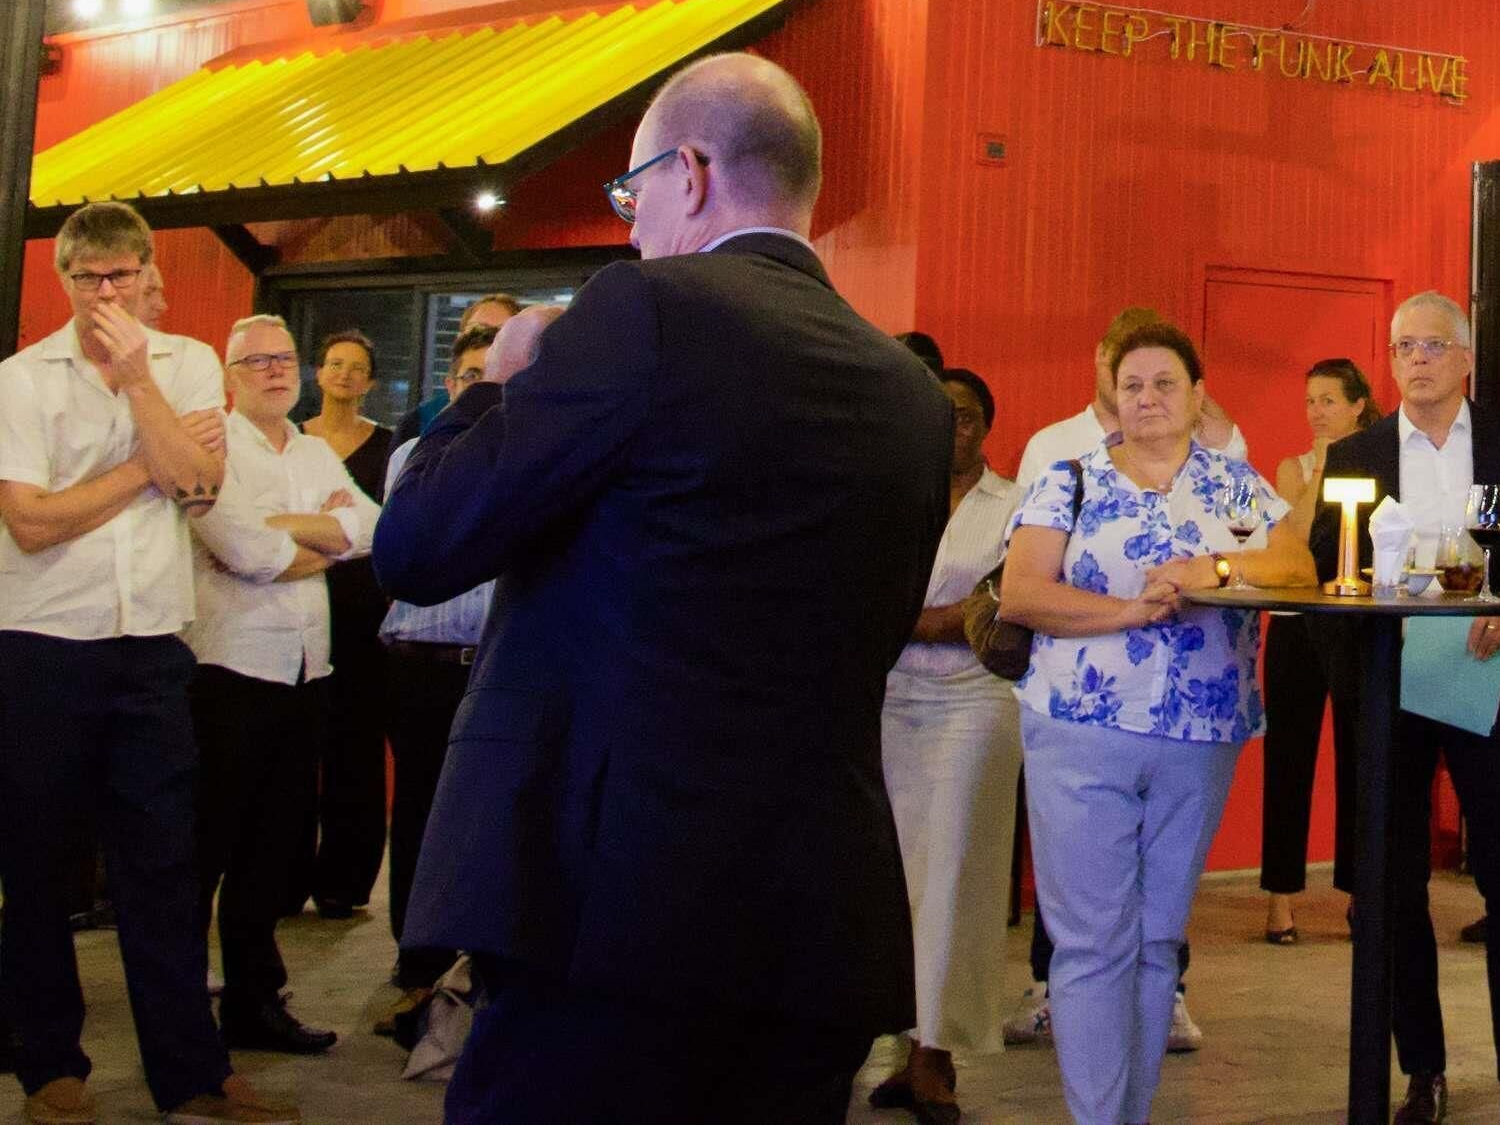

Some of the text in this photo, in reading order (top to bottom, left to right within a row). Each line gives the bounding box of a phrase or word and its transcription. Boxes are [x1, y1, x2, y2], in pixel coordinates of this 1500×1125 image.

[1046, 0, 1468, 99] KEEP THE FUNK ALIVE
